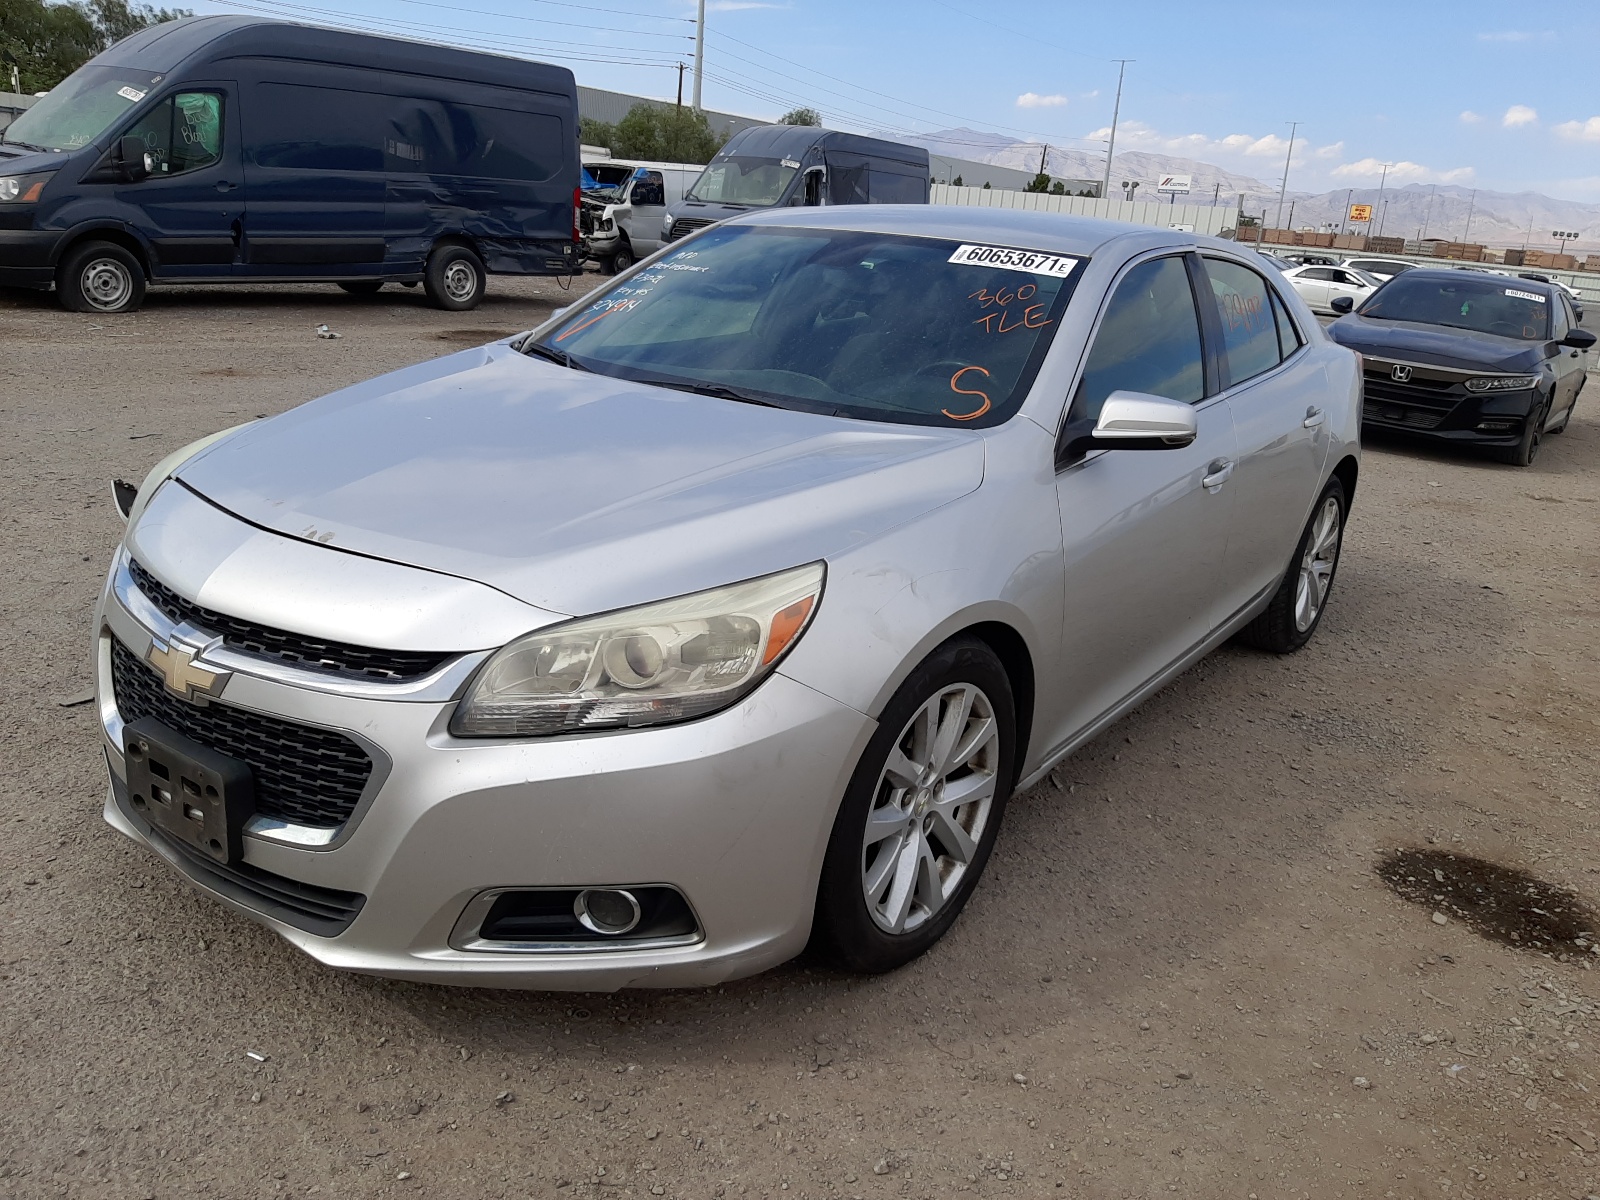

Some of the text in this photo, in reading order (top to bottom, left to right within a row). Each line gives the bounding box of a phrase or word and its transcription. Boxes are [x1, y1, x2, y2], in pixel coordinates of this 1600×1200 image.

[966, 247, 1061, 272] 60653671
[968, 284, 1037, 309] 360
[972, 303, 1054, 334] TLE
[941, 366, 992, 421] S
